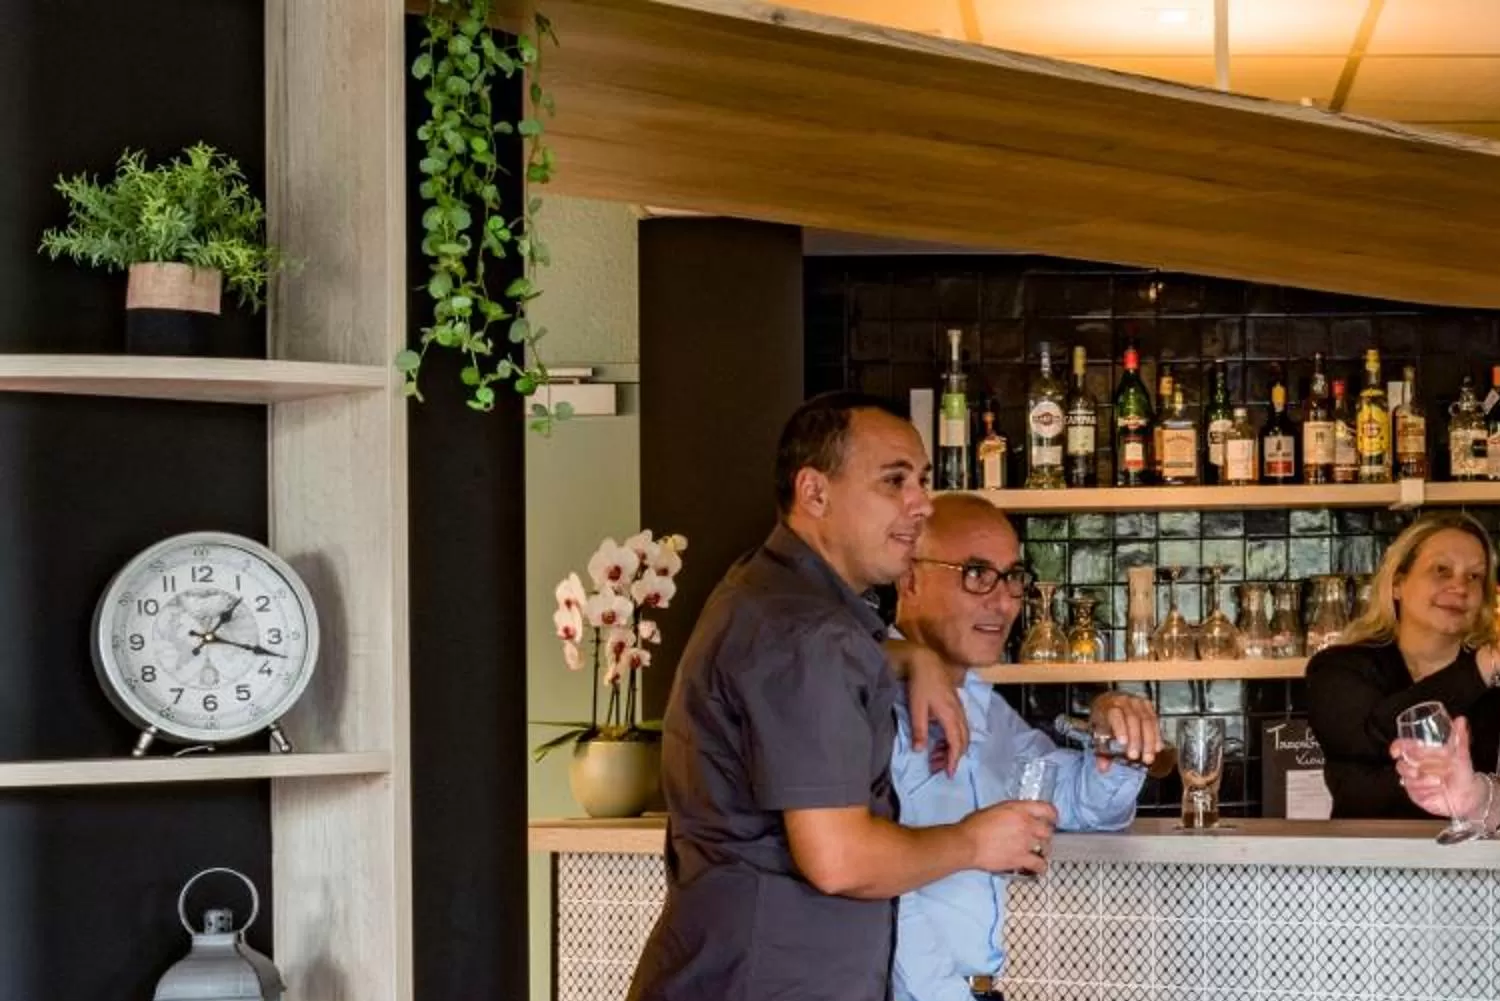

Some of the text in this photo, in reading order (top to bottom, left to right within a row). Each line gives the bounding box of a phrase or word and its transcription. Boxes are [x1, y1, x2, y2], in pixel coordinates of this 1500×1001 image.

[191, 566, 214, 583] 12
[235, 575, 241, 591] 1
[163, 575, 177, 593] 11
[137, 599, 159, 616] 10
[255, 595, 271, 613] 2
[129, 633, 145, 651] 9
[267, 628, 283, 645] 3
[141, 665, 157, 683] 8
[258, 661, 273, 677] 4
[170, 688, 185, 705] 7
[236, 684, 251, 701] 5
[203, 695, 218, 712] 6
